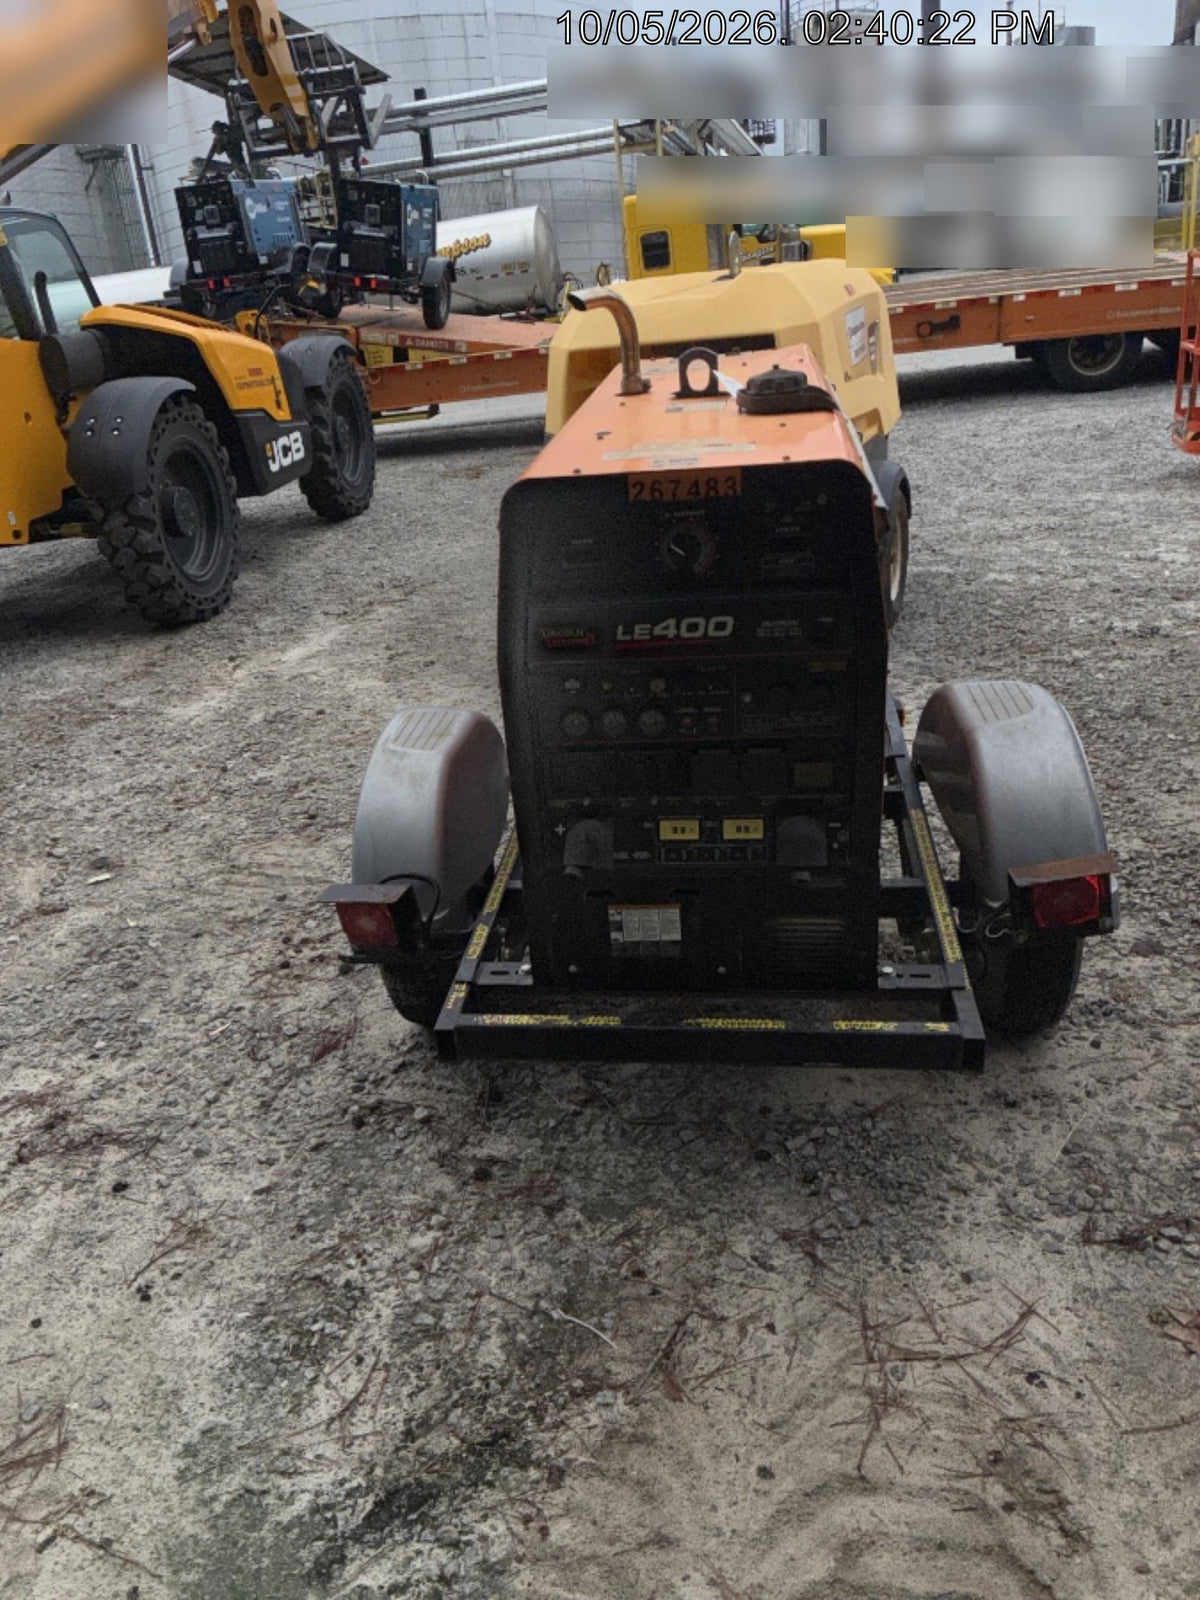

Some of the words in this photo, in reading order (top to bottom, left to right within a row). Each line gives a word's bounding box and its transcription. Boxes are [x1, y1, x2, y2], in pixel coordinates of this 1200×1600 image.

[266, 430, 305, 472] JCB
[631, 475, 738, 502] 267483
[616, 615, 735, 641] LE400
